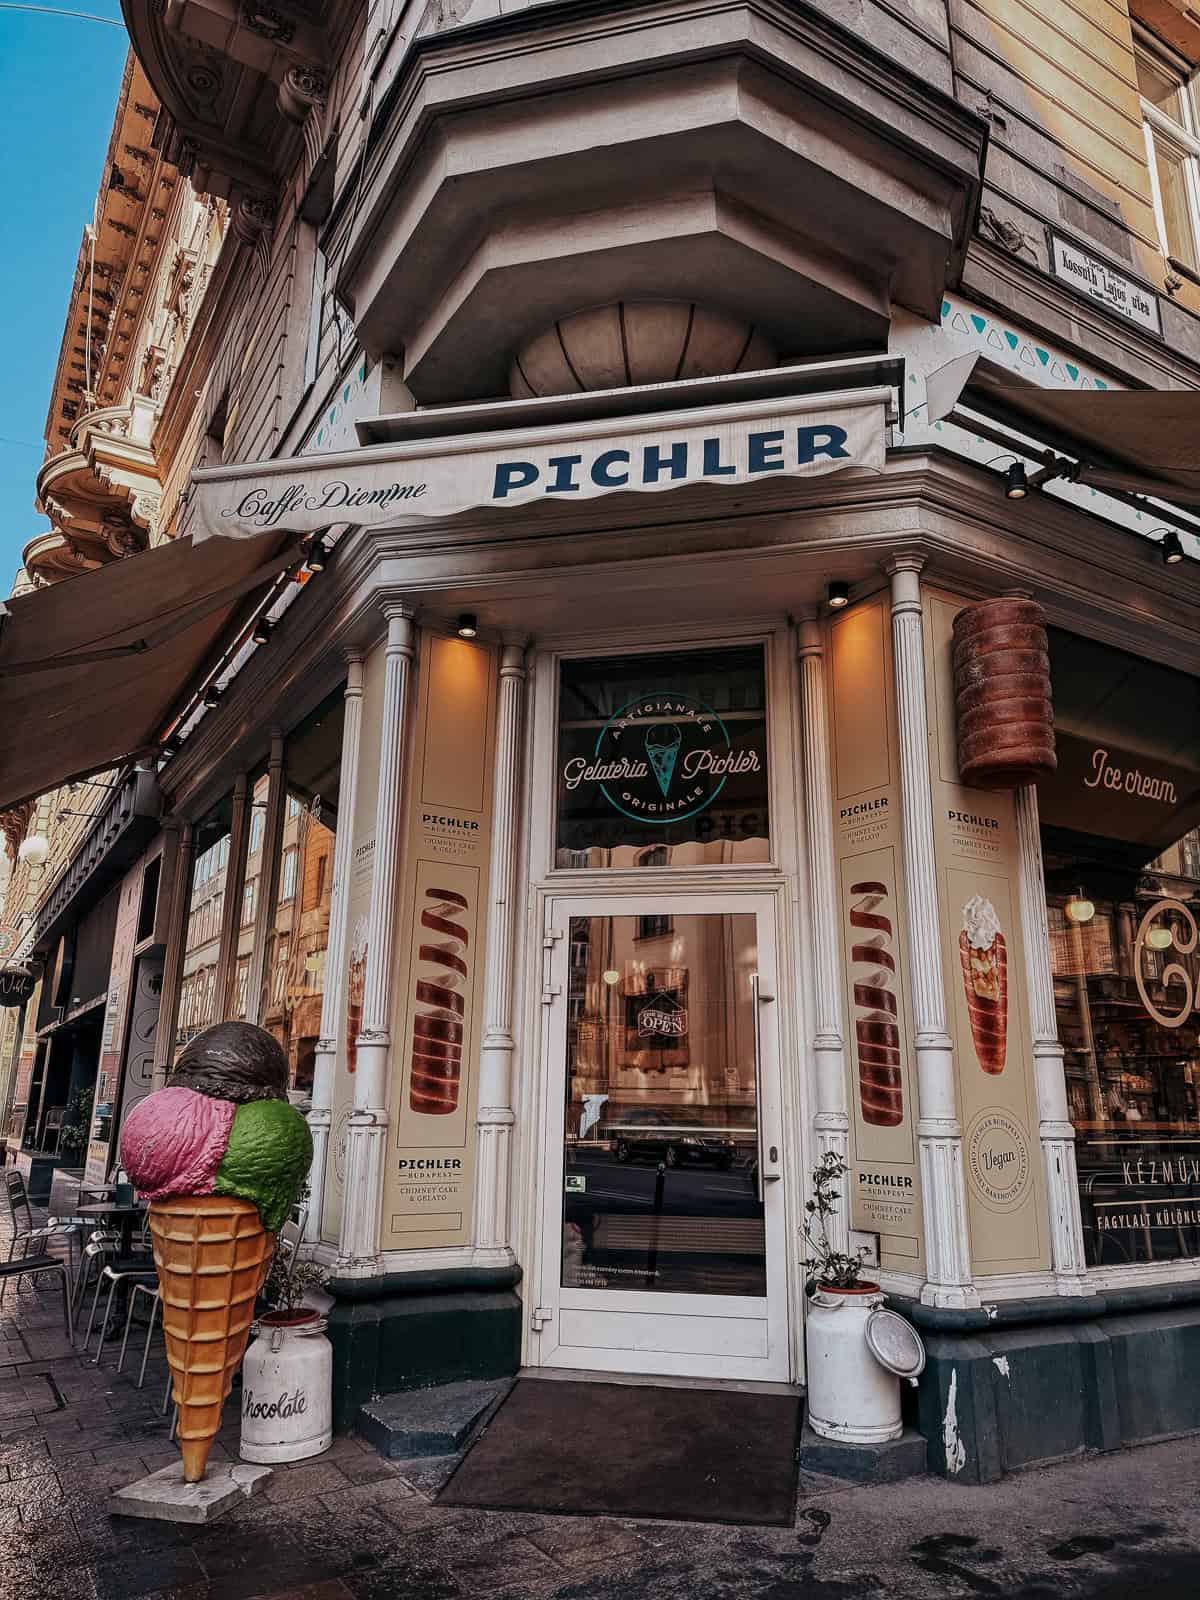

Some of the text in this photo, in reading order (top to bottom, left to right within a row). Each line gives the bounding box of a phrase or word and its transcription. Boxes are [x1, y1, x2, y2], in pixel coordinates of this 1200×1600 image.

[1102, 274, 1127, 303] Lajos
[492, 424, 851, 499] PICHLER
[305, 480, 427, 510] Diemme
[613, 702, 712, 740] ARTIGIANALE
[564, 750, 760, 790] Gelateria Pichler
[622, 786, 703, 812] ORIGINALE
[840, 797, 888, 819] PICHLER
[422, 814, 479, 830] PICHLER
[948, 810, 999, 829] PICHLER
[643, 1016, 682, 1033] OPEN
[398, 1159, 461, 1170] PICHLER
[982, 1148, 1016, 1170] Vegan
[859, 1173, 913, 1188] PICHLER
[1097, 1213, 1151, 1231] FAGYLALT
